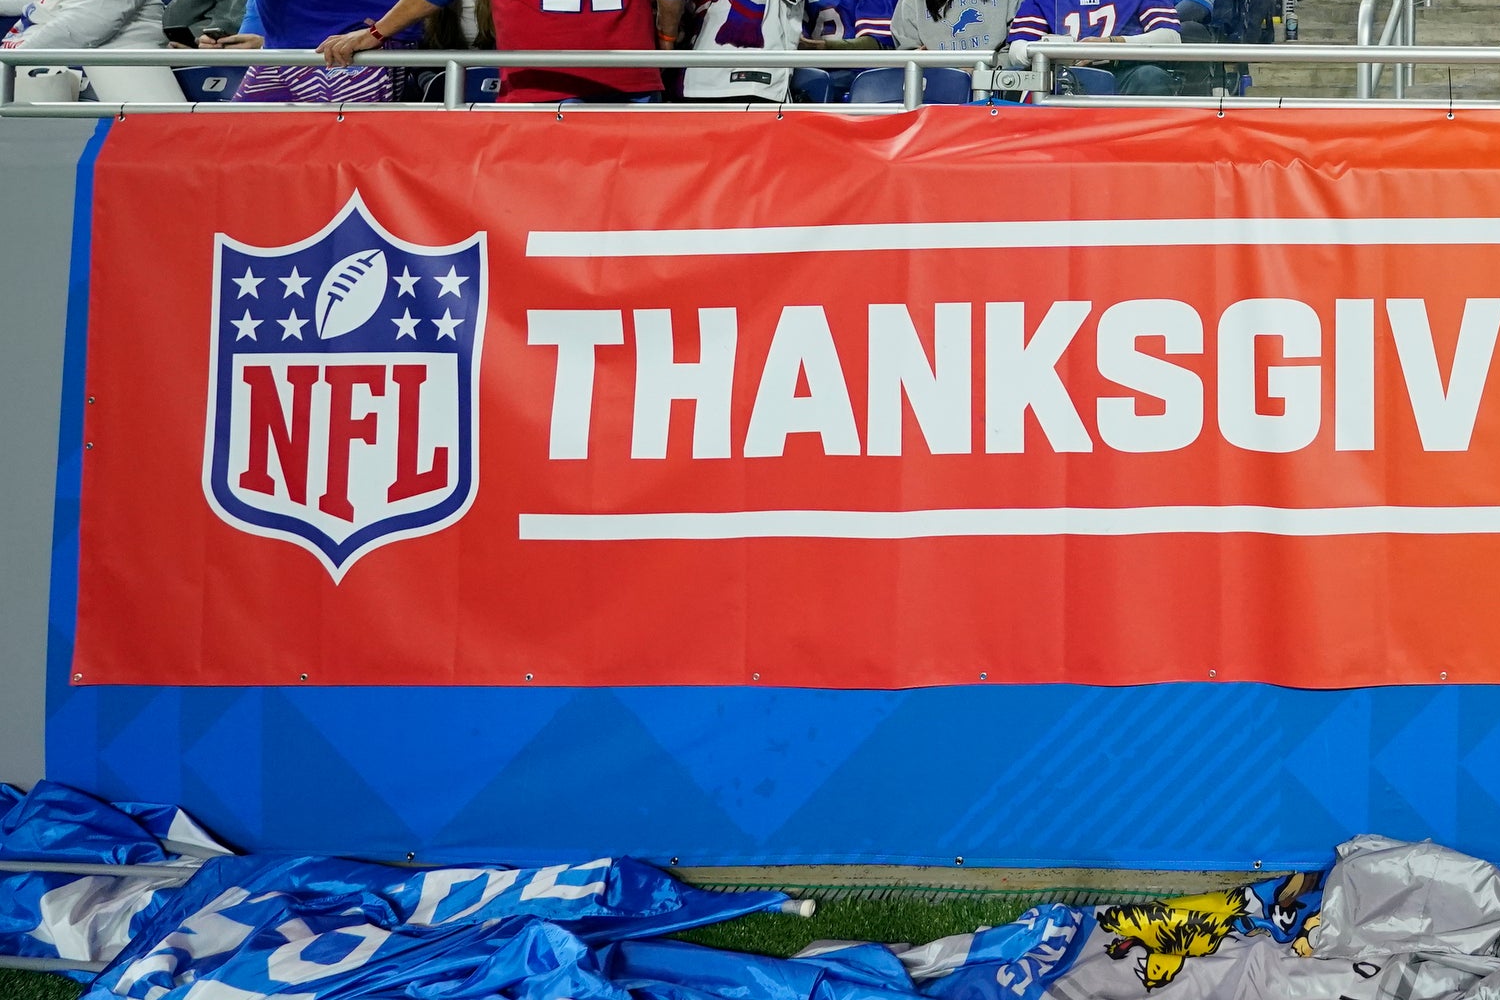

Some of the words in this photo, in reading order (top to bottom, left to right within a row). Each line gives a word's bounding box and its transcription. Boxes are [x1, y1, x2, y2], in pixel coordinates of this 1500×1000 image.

[1064, 4, 1117, 40] 17
[938, 34, 991, 51] LIONS
[238, 364, 449, 524] NFL
